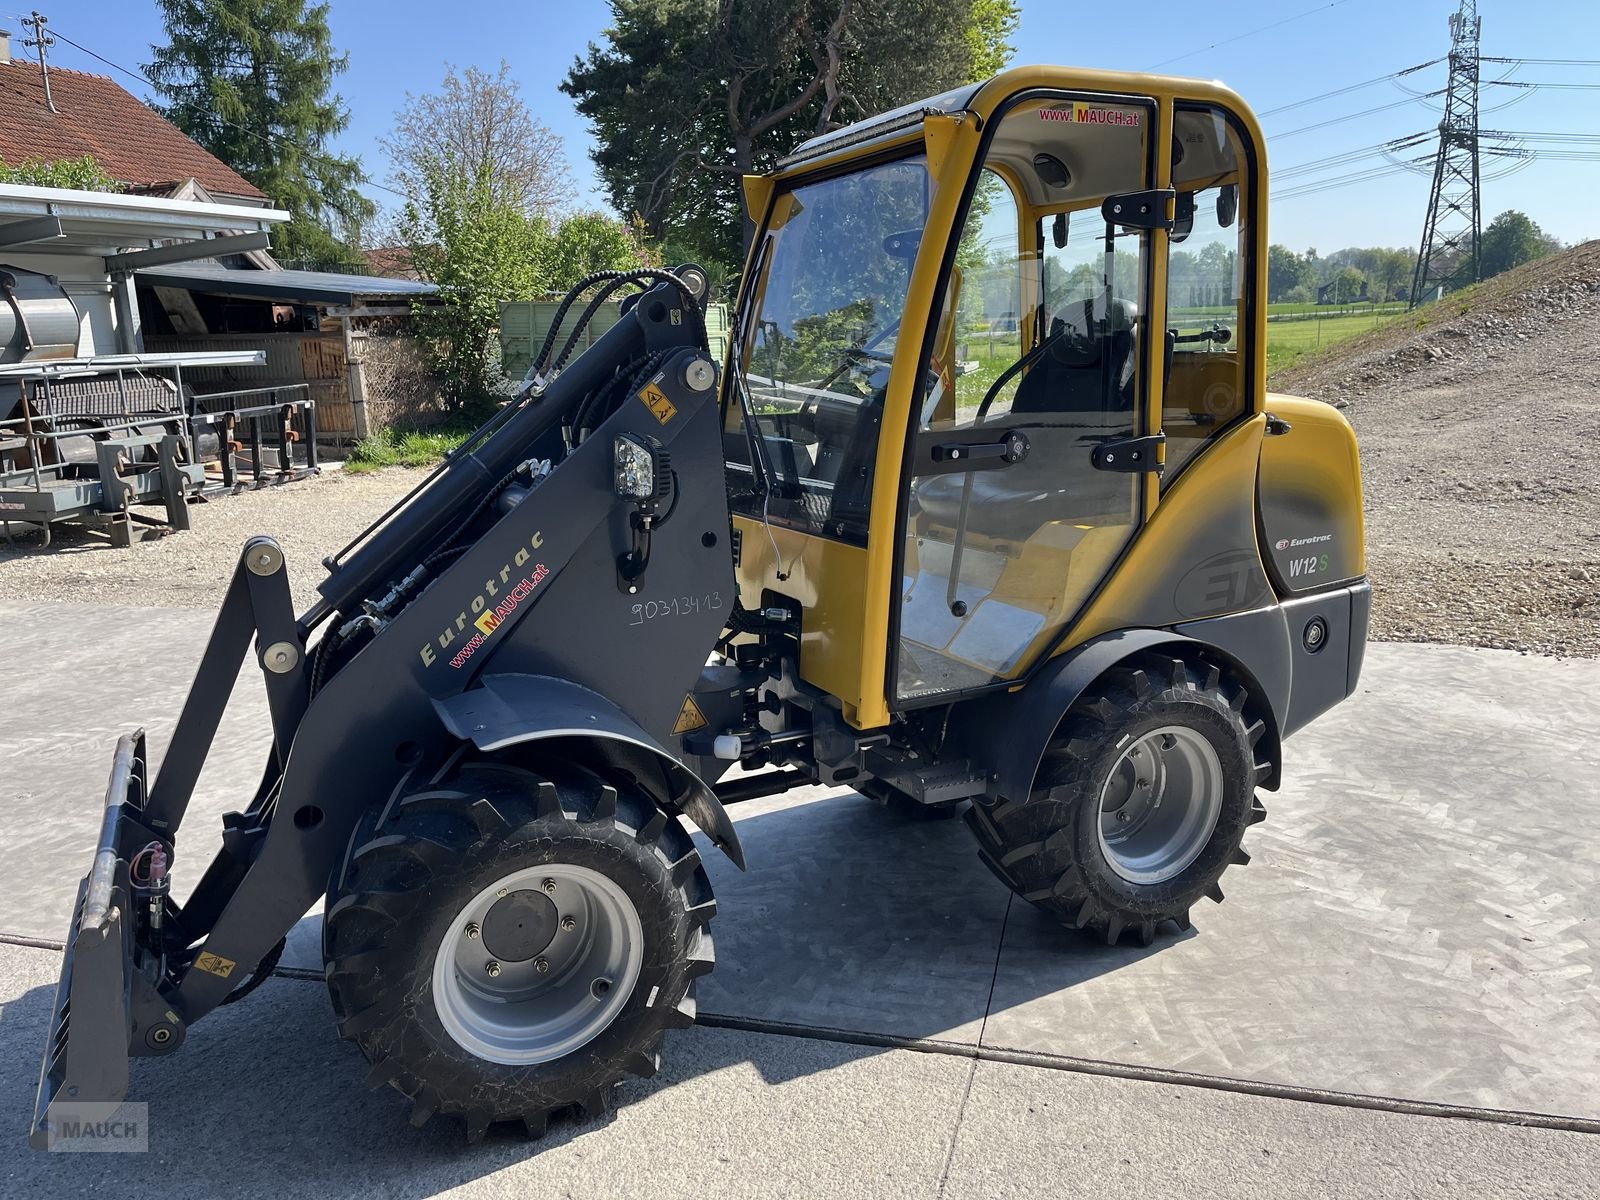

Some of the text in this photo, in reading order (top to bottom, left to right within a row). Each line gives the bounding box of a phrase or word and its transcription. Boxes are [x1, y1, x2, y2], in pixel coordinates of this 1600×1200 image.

[1039, 108, 1139, 126] www.MAUCH.at
[1290, 534, 1332, 547] Eurotrac
[420, 530, 545, 668] Eurotrac
[449, 563, 550, 669] www.MAUCH.at
